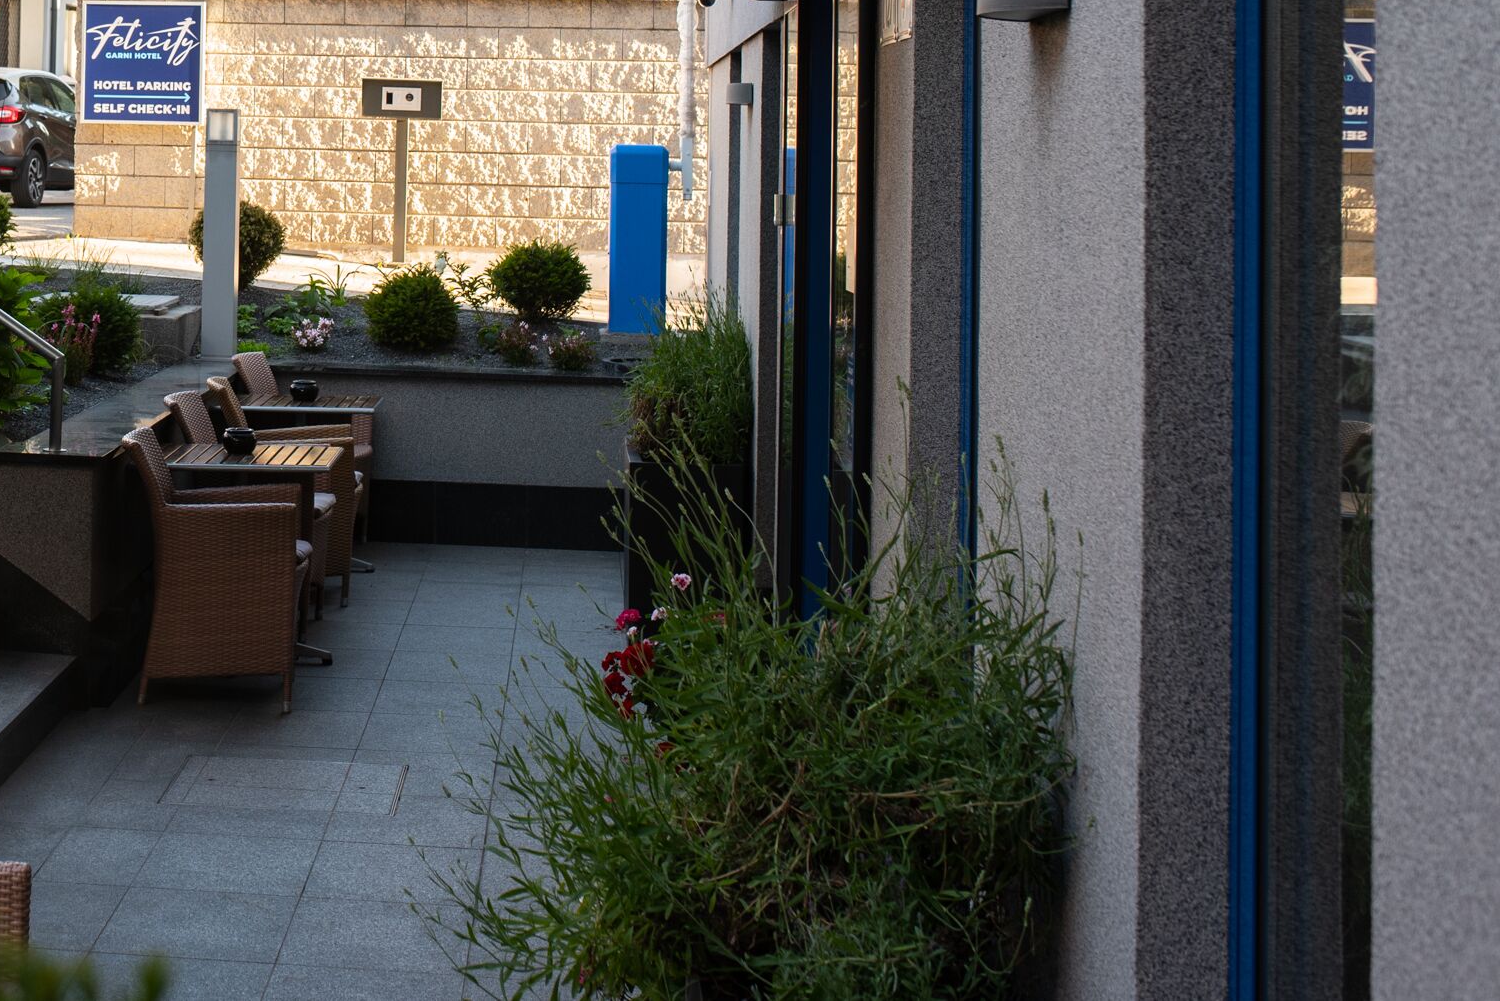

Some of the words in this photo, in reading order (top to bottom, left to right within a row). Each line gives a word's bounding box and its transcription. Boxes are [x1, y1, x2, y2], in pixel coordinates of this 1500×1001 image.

[86, 16, 200, 66] Felicity
[134, 52, 162, 60] HOTEL
[93, 80, 134, 91] HOTEL
[136, 81, 191, 92] PARKING
[93, 103, 125, 114] SELF
[128, 104, 190, 115] CHECK-IN
